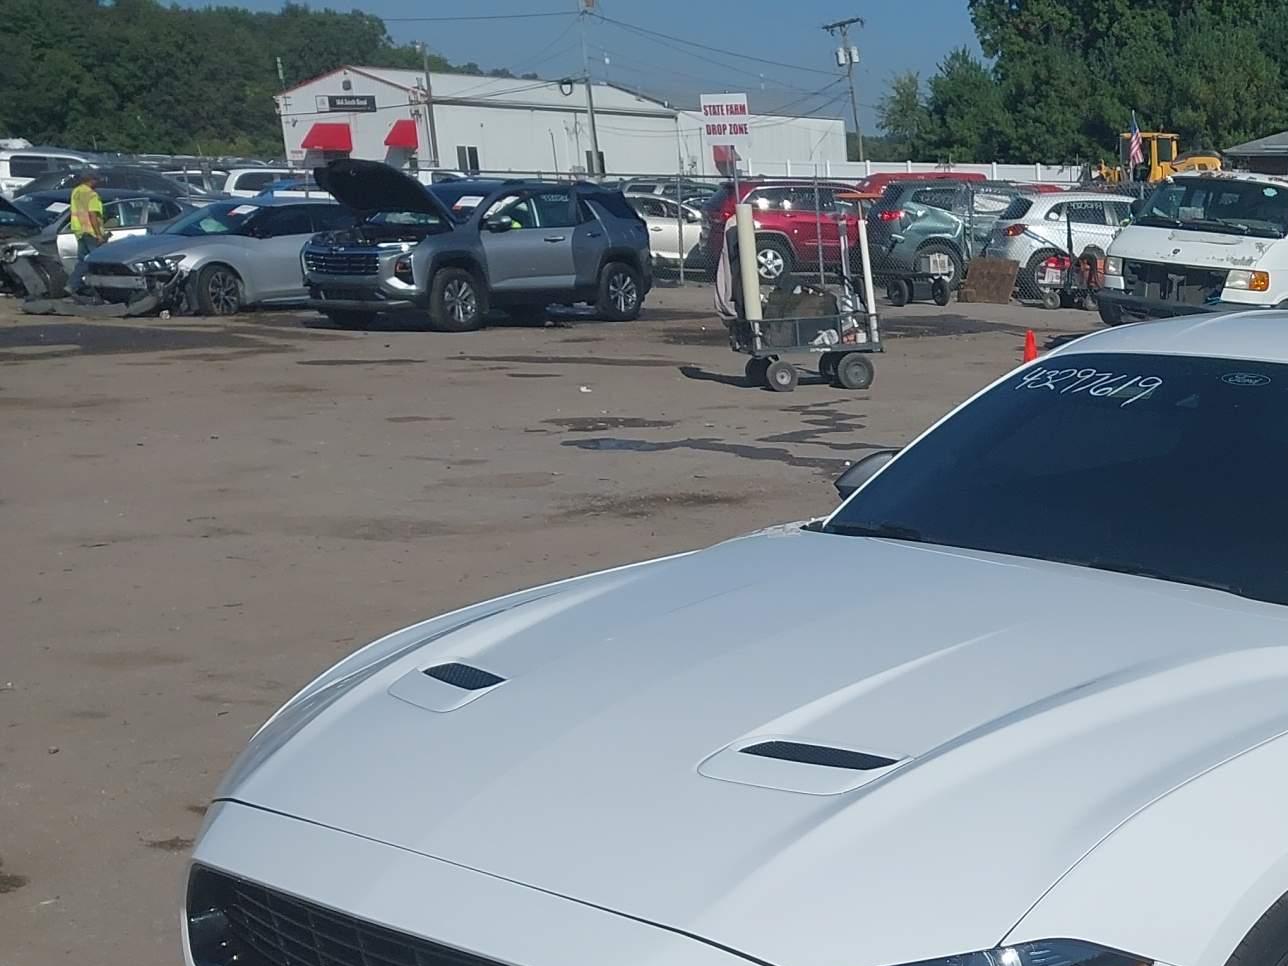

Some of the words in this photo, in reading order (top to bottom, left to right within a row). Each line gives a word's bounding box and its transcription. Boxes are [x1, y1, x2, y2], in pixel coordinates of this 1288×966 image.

[703, 105, 724, 116] STATE
[726, 104, 746, 116] FARM
[706, 124, 727, 136] DROP
[728, 123, 749, 135] ZONE
[1015, 366, 1164, 408] 43297619
